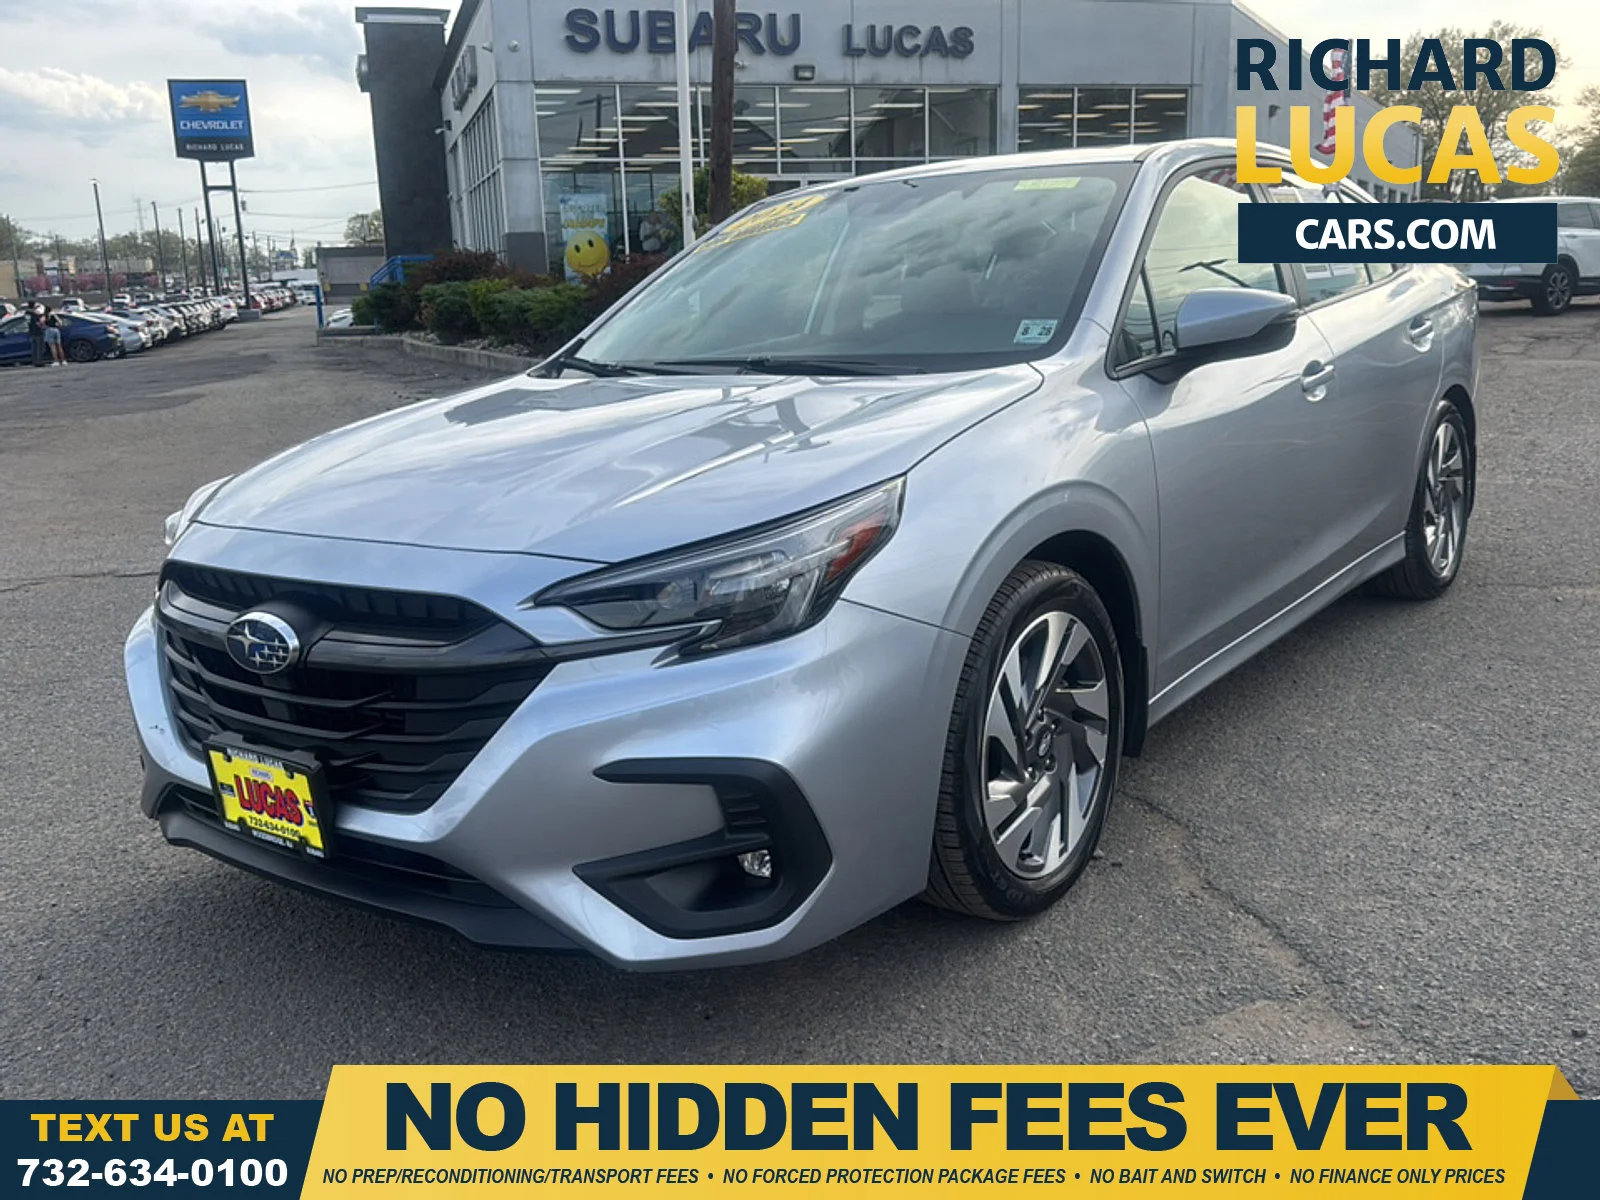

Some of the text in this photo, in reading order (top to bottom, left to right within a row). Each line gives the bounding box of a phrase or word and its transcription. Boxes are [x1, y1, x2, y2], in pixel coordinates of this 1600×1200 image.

[564, 8, 975, 59] SUBARU LUCAS
[180, 119, 243, 130] CHEVROLET
[234, 774, 303, 826] LUCAS
